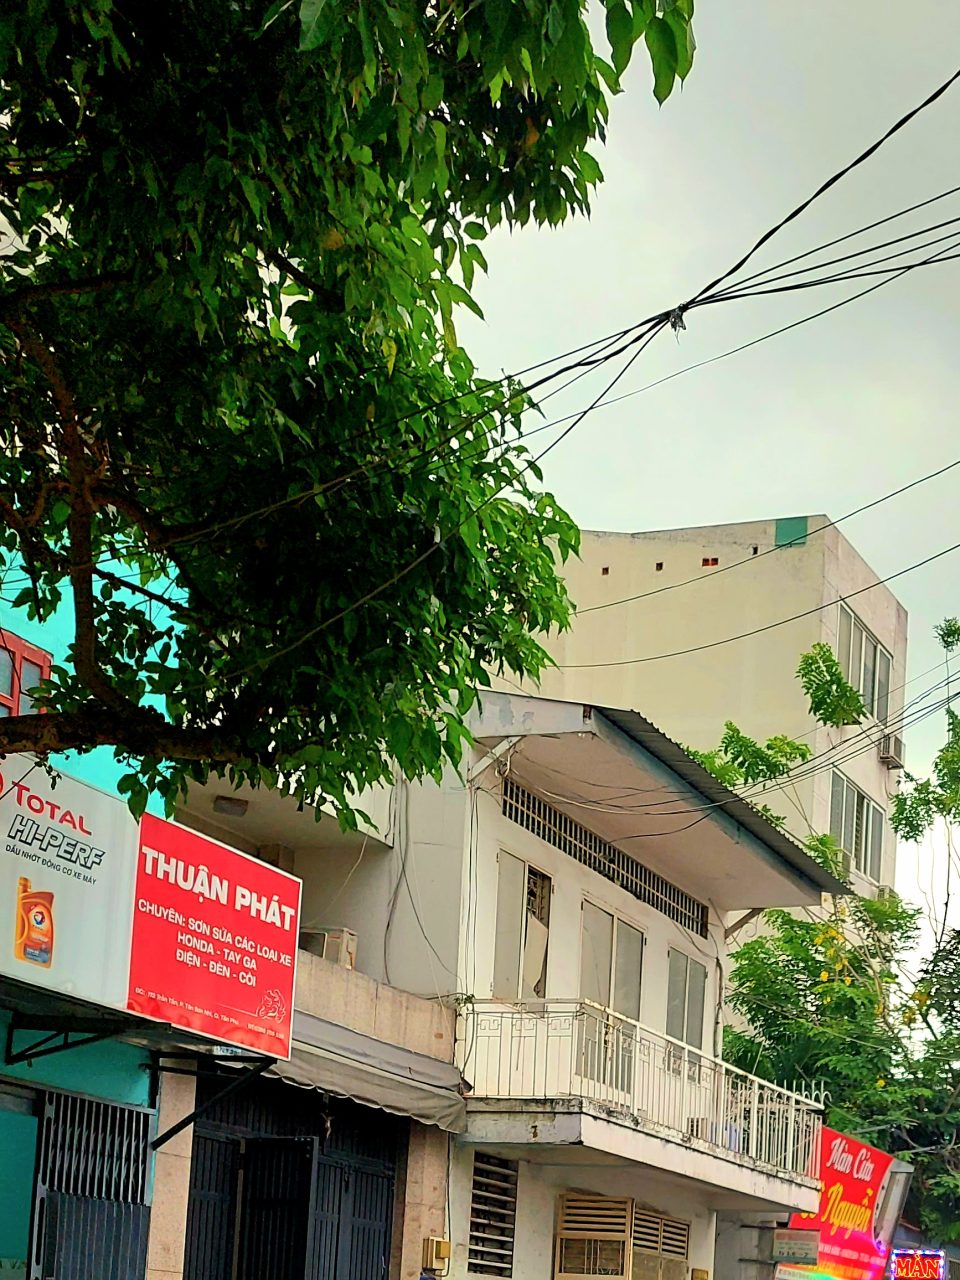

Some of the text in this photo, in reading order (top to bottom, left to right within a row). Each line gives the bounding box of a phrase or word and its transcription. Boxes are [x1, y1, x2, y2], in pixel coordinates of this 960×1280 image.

[11, 780, 92, 836] TOTAL
[7, 813, 106, 870] HI-PERF
[141, 844, 296, 932] THUẬN PHÁT
[138, 898, 186, 927] CHUYÊN:
[188, 918, 211, 937] SƠN
[234, 934, 256, 953] CÁC
[279, 953, 293, 967] XE
[177, 930, 214, 955] HONDA
[223, 948, 242, 965] TAY
[243, 957, 257, 971] GA
[176, 948, 201, 968] ĐIỆN
[825, 1137, 875, 1182] Màn Cửa
[895, 1253, 940, 1279] MÀN
